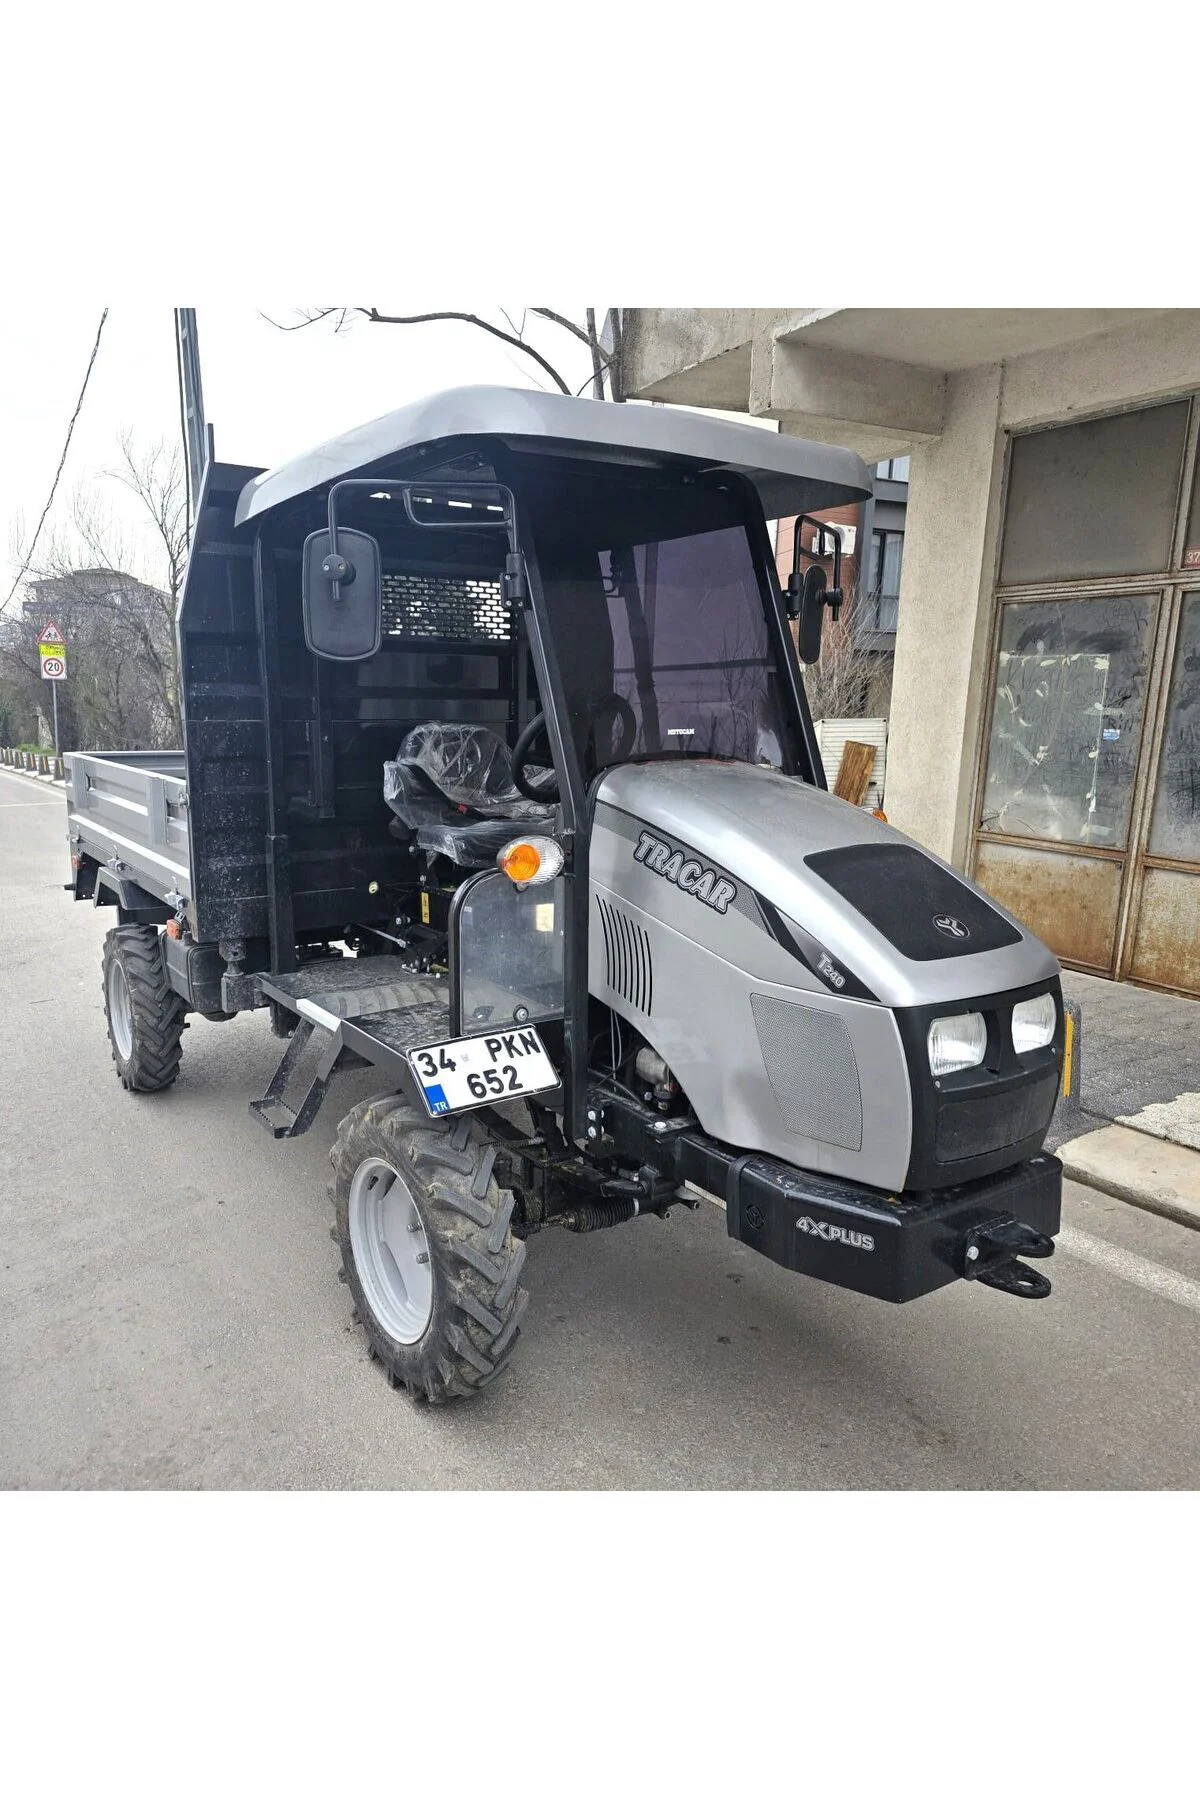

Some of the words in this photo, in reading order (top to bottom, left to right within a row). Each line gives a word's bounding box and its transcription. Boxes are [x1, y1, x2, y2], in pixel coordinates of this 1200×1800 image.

[47, 662, 60, 672] 20
[634, 830, 737, 914] TRACAR
[816, 952, 845, 988] T240
[417, 1048, 457, 1077] 34
[484, 1031, 541, 1062] PKN
[466, 1065, 523, 1099] 652
[433, 1102, 448, 1112] TR
